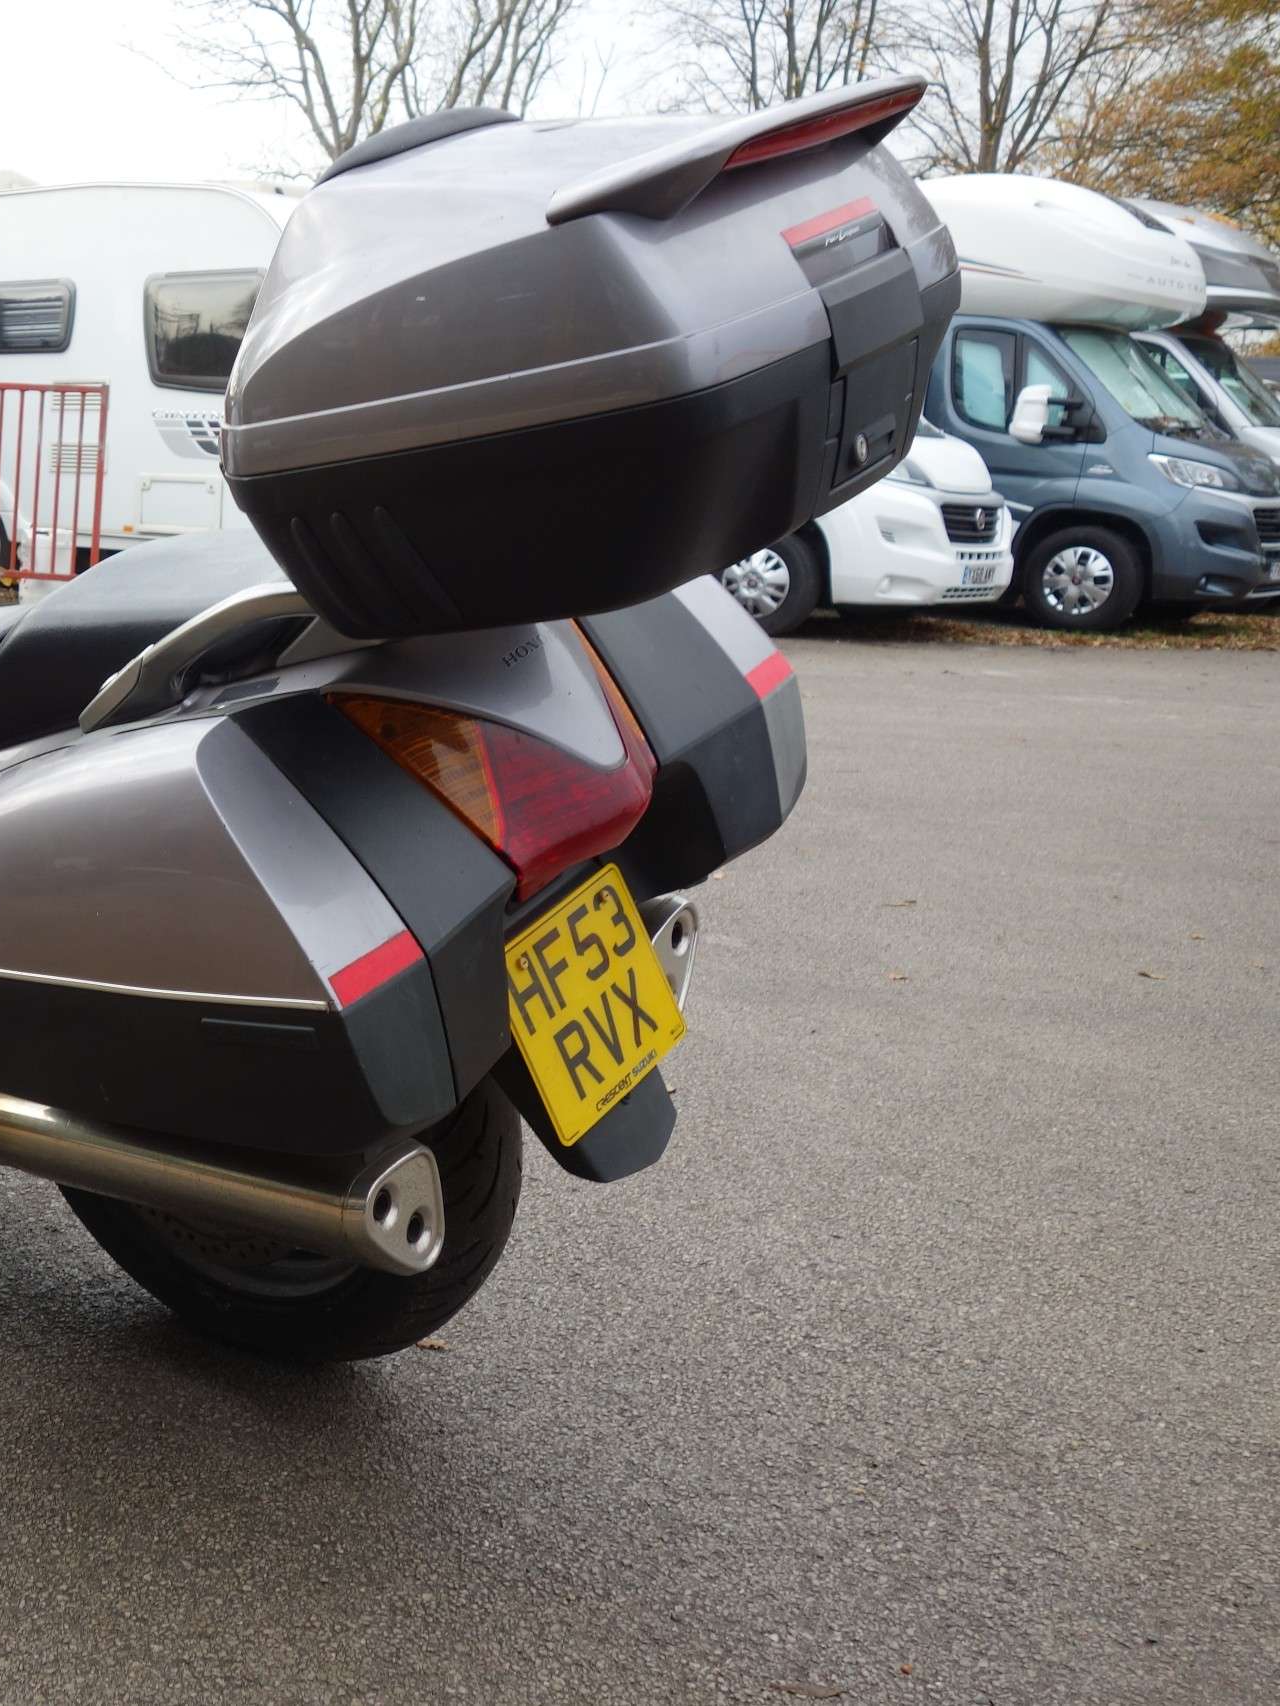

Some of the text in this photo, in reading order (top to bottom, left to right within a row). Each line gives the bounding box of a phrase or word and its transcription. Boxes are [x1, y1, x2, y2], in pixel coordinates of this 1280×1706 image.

[501, 634, 544, 668] HON
[508, 884, 636, 1036] HF53
[552, 967, 659, 1101] RVX
[596, 1073, 632, 1112] CRESCENT
